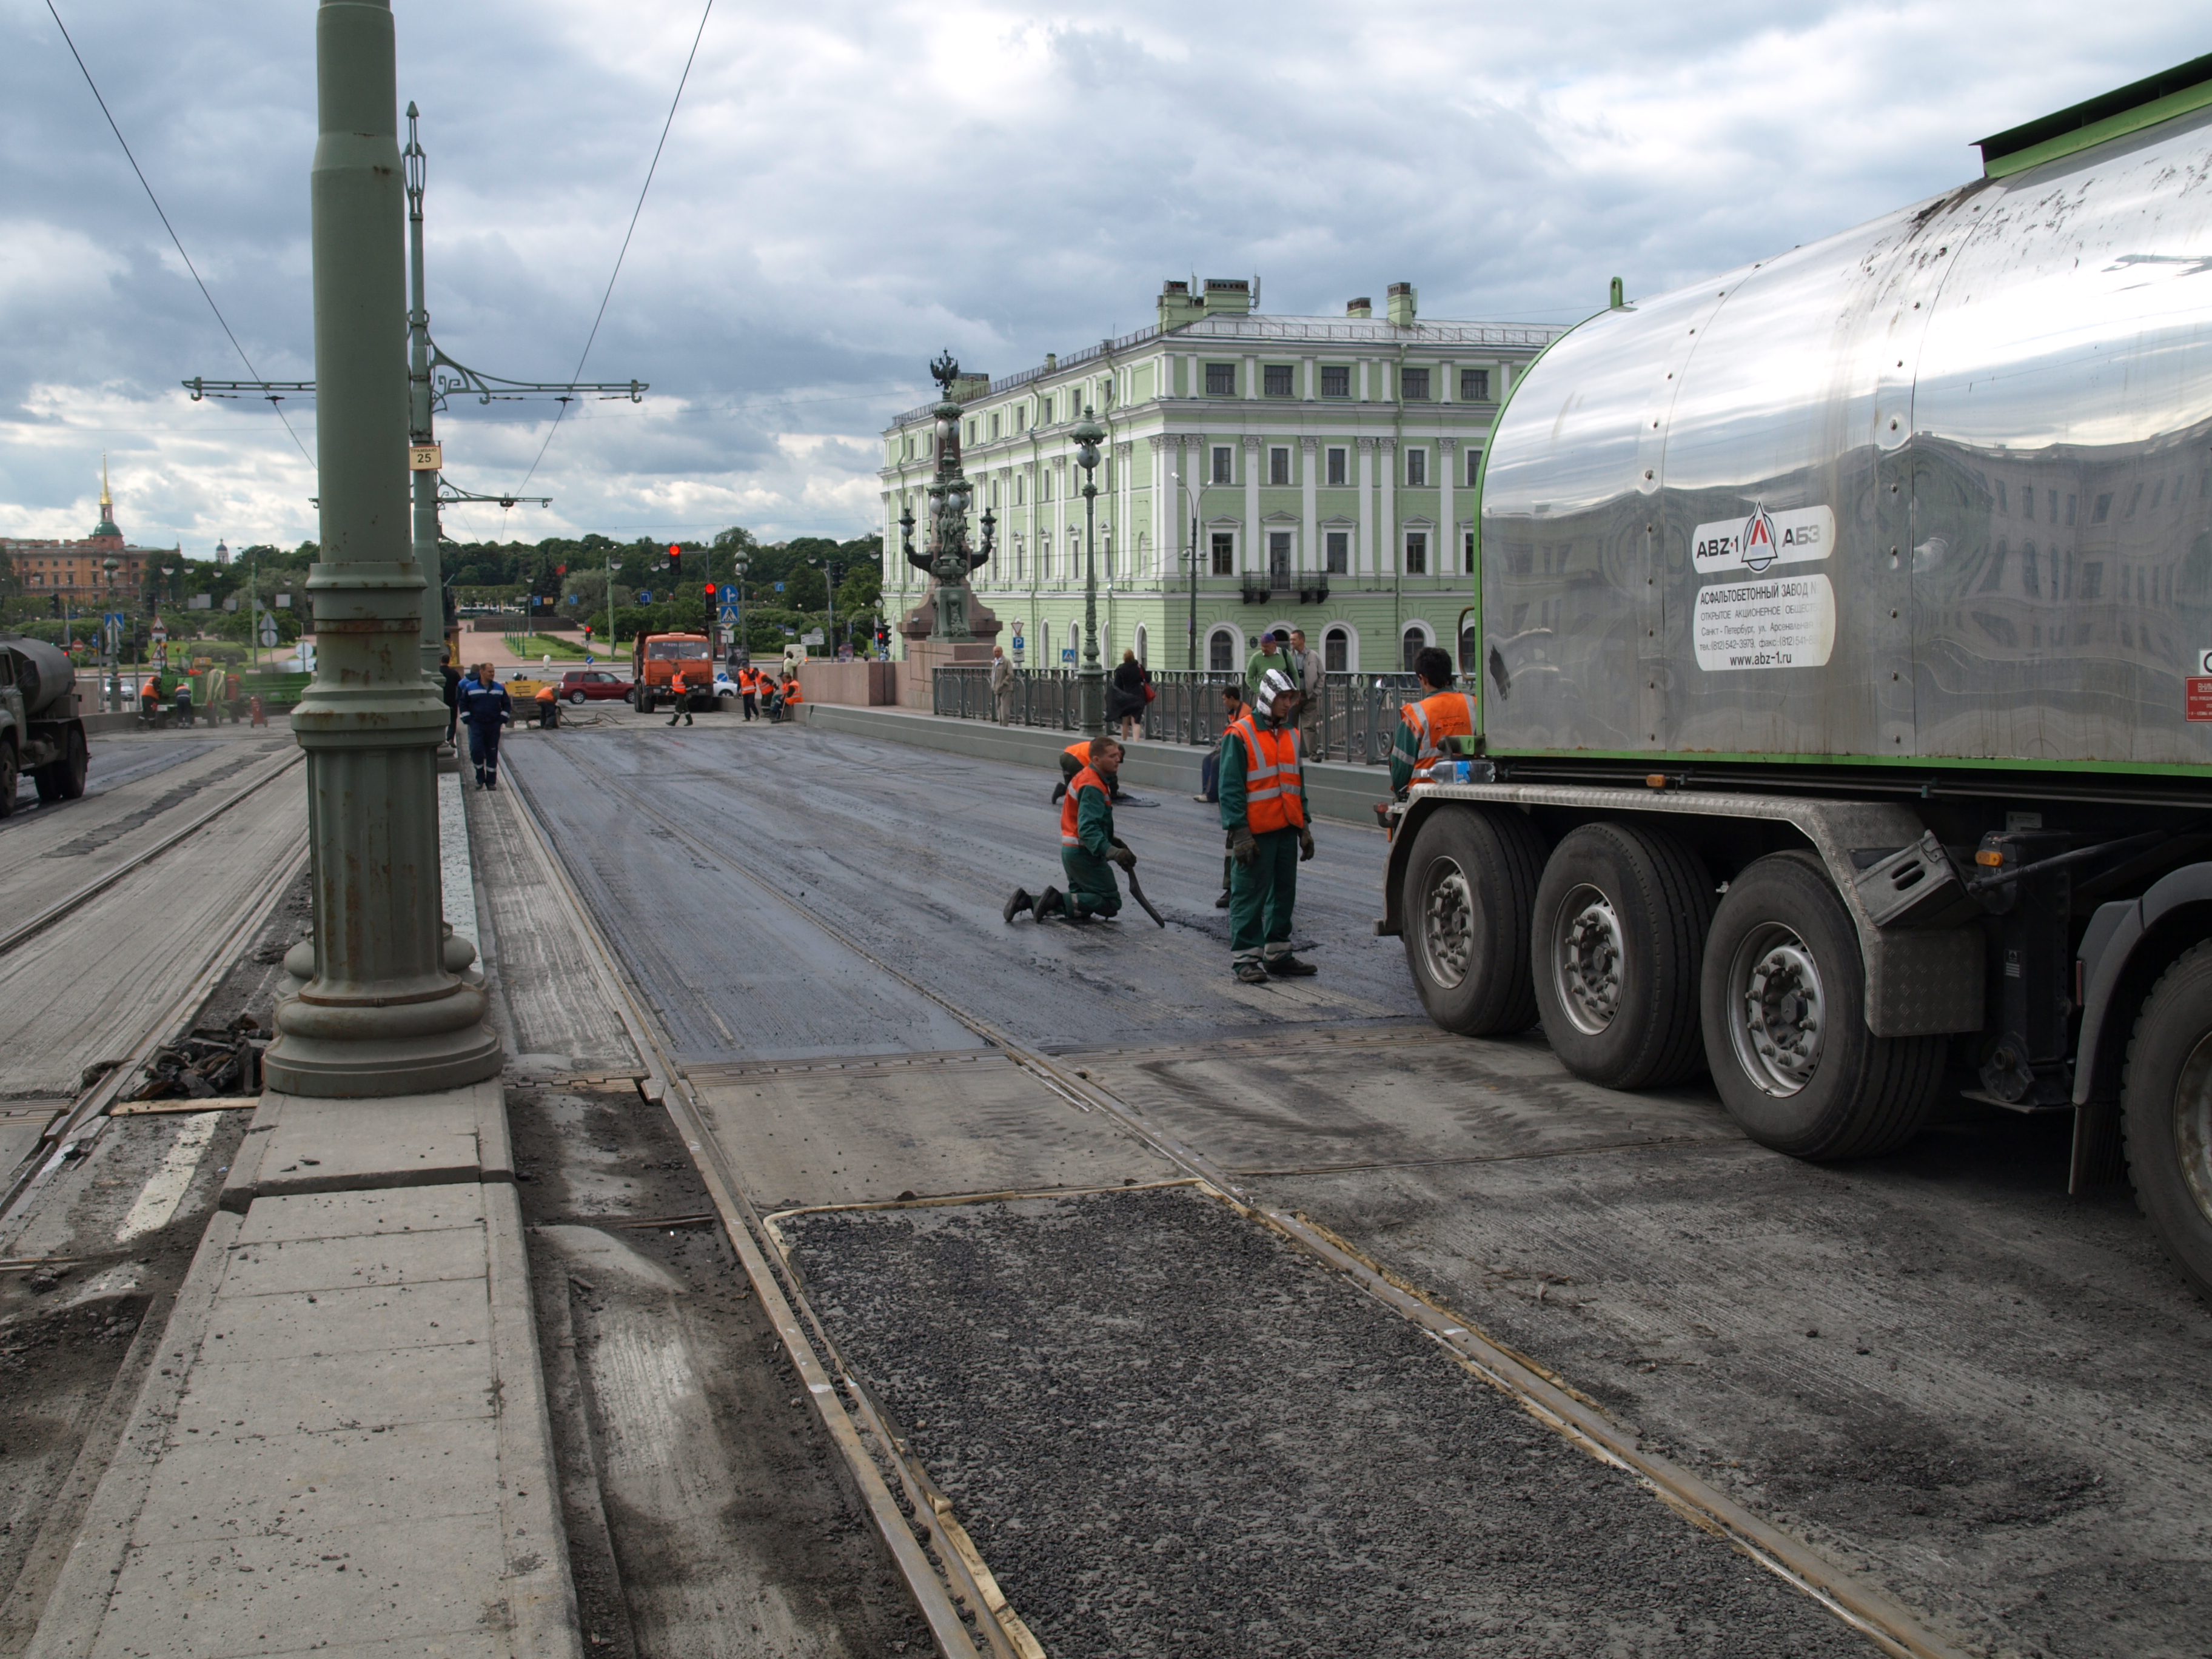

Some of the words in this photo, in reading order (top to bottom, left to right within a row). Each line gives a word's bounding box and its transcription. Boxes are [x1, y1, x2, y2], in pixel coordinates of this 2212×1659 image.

[417, 453, 431, 463] 25
[1700, 582, 1779, 605] АСФАЛЬТОБЕТОННЫЙ
[1781, 582, 1809, 598] ЗАВОД
[1701, 610, 1732, 621] ОТКРЫТОЕ
[1735, 606, 1781, 618] АКЦИОНЕРНОЕ
[1730, 651, 1792, 666] www.abz-1.ru
